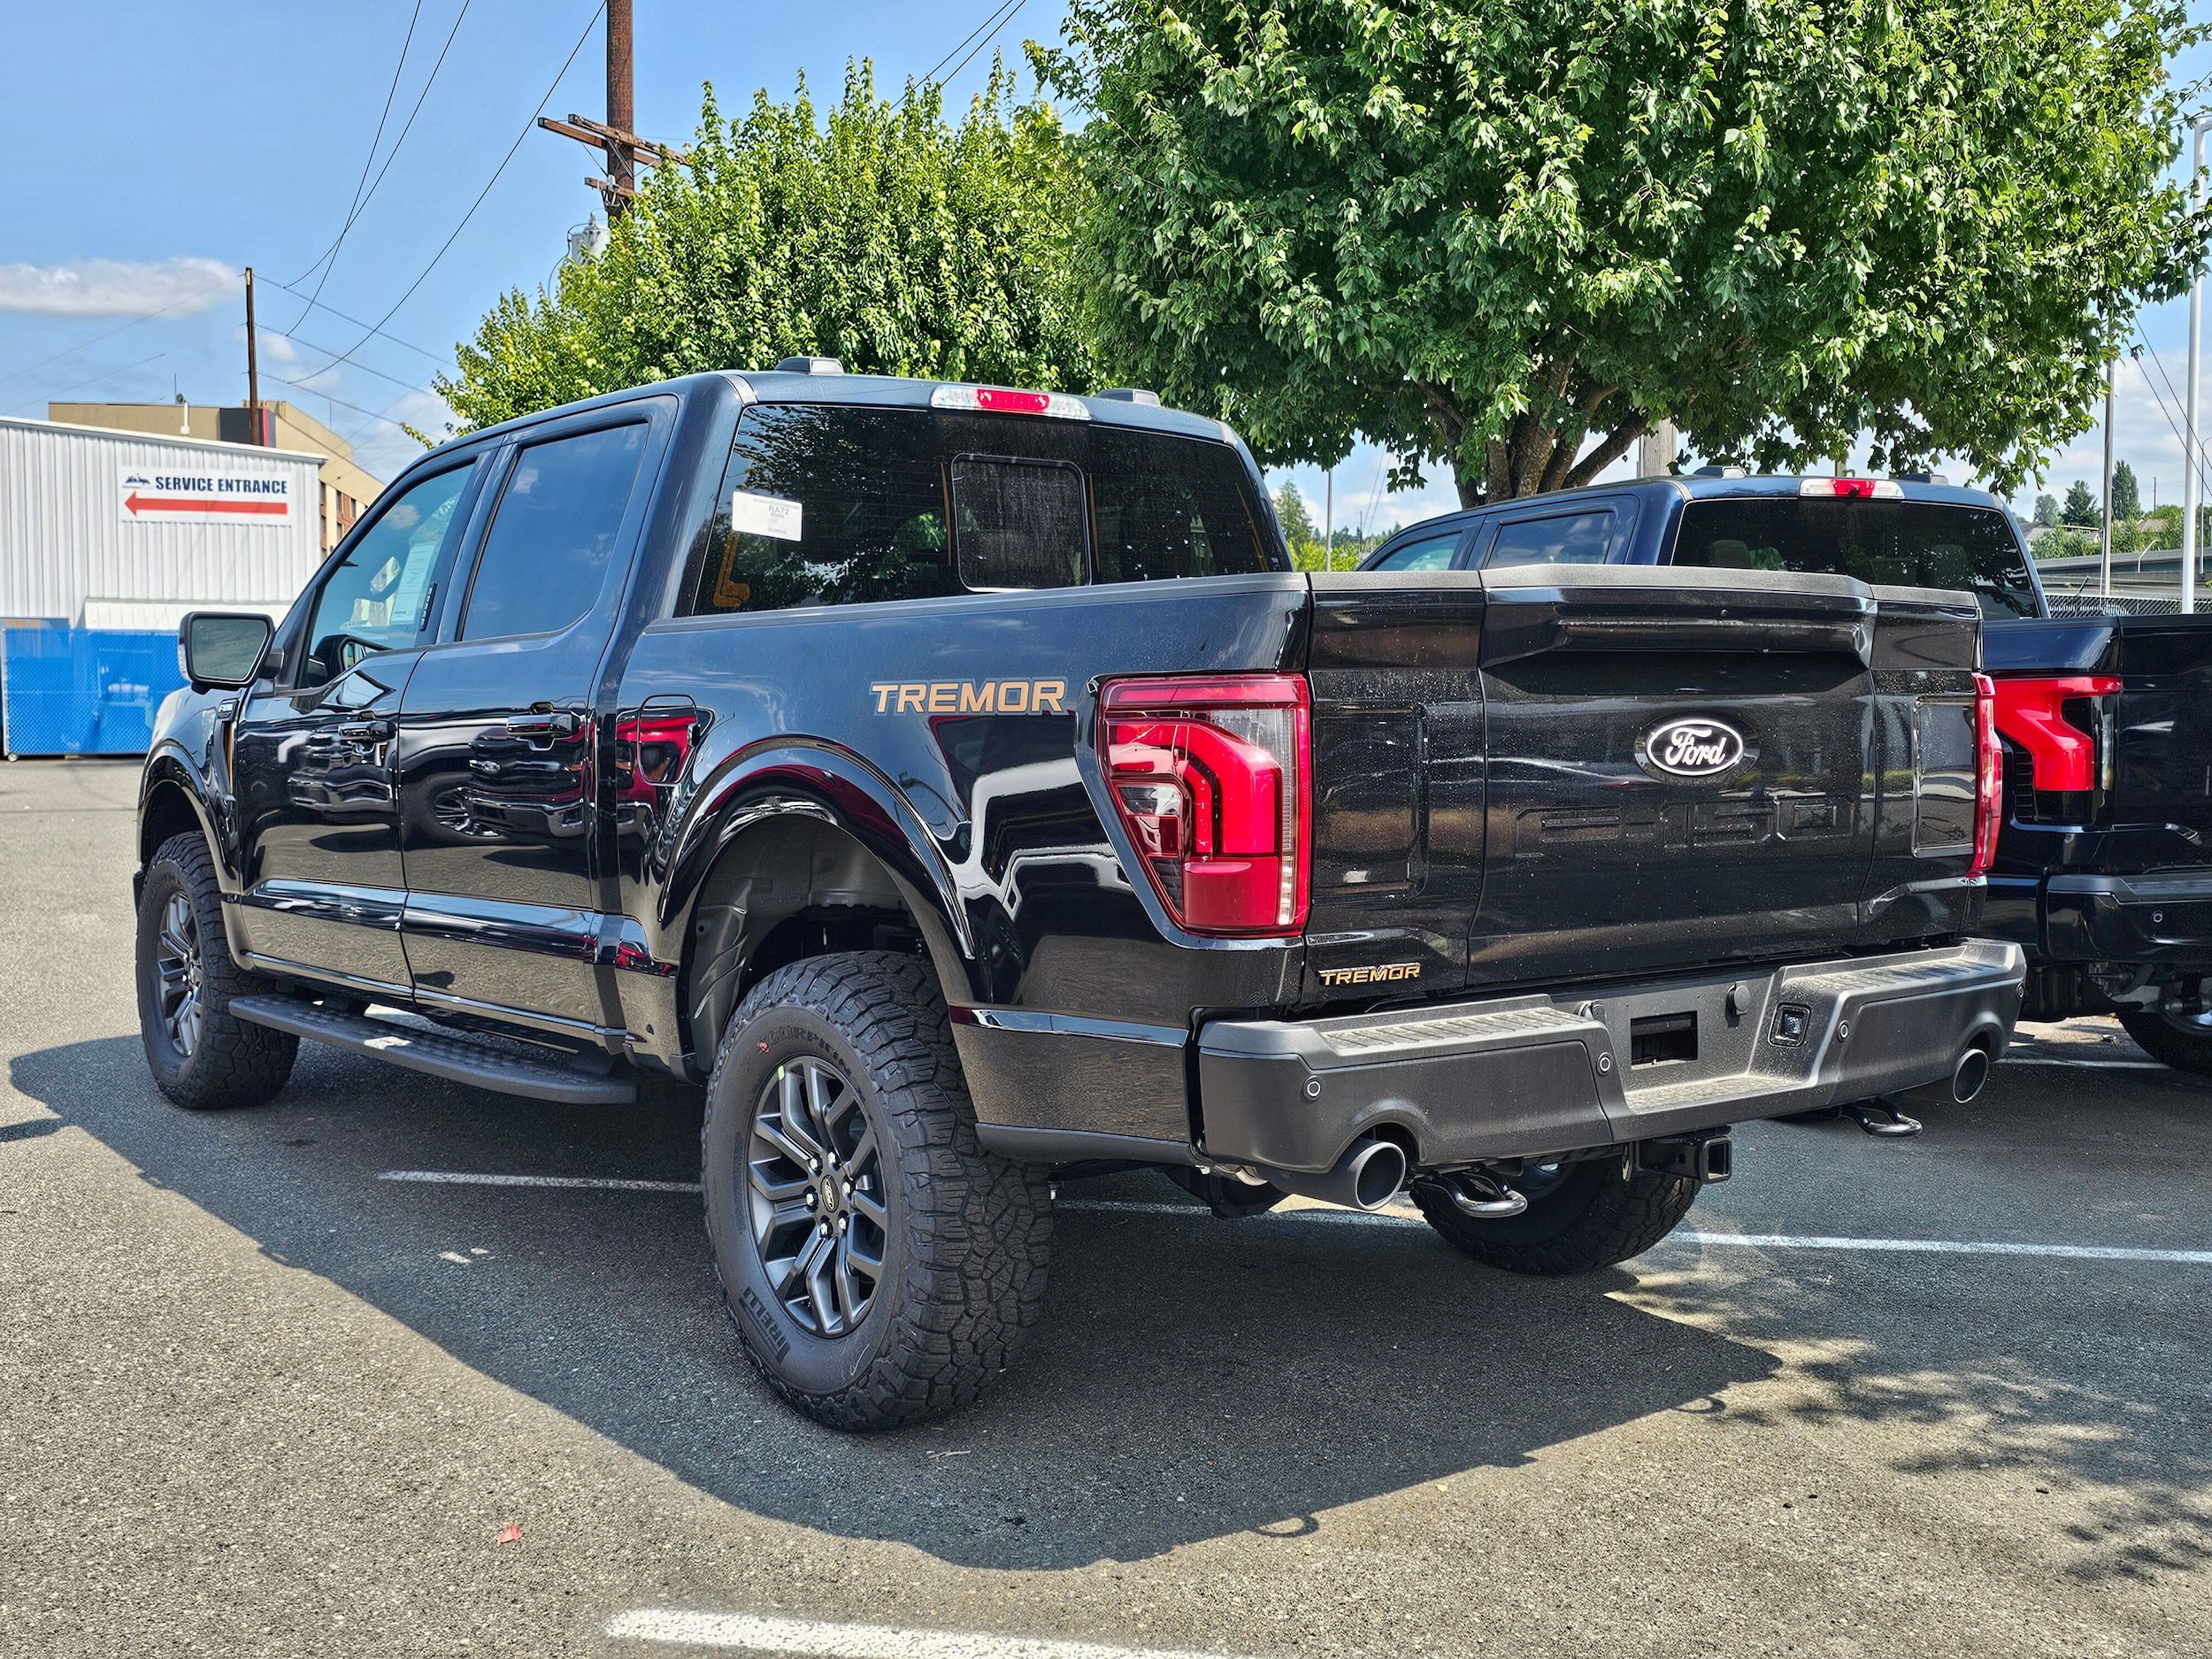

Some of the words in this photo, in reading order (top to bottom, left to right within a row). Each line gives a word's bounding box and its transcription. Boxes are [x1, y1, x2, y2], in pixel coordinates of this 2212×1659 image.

[156, 476, 213, 492] SERVICE
[218, 479, 288, 494] ENTRANCE
[871, 679, 1066, 714] TREMOR
[1665, 727, 1727, 766] Ford
[1318, 963, 1422, 987] TREMOR
